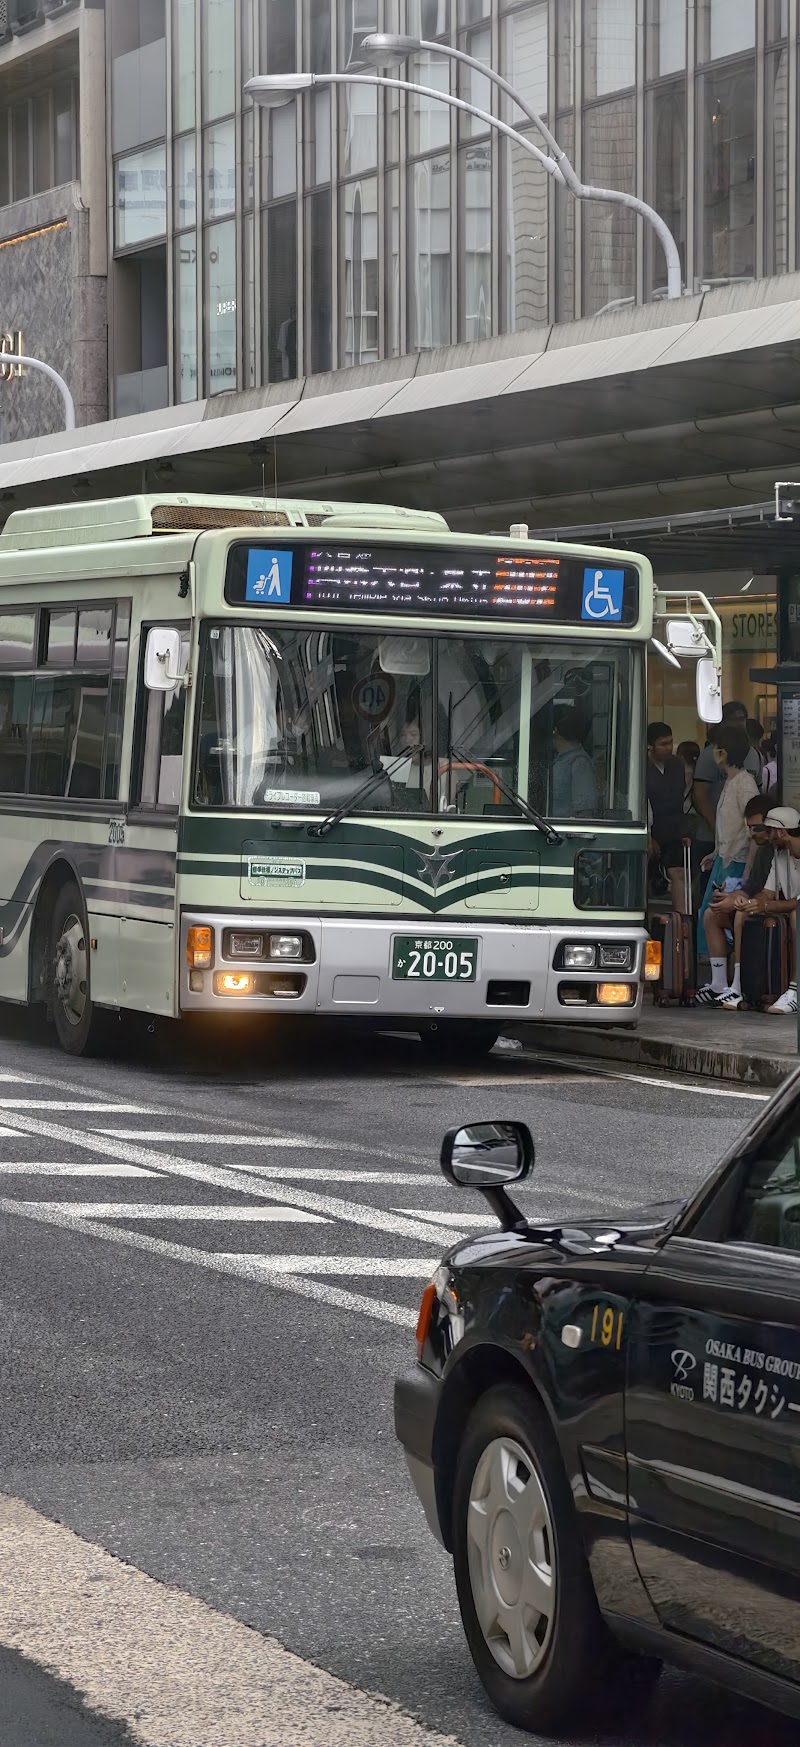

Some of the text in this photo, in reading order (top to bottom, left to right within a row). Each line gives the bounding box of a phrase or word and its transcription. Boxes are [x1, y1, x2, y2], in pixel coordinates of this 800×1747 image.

[397, 951, 473, 978] か 20-05
[590, 1304, 624, 1351] 191
[705, 1338, 741, 1363] OSAKA
[743, 1348, 766, 1369] BUS
[670, 1381, 695, 1402] KYOTO
[702, 1361, 800, 1419] 関西タクシー
